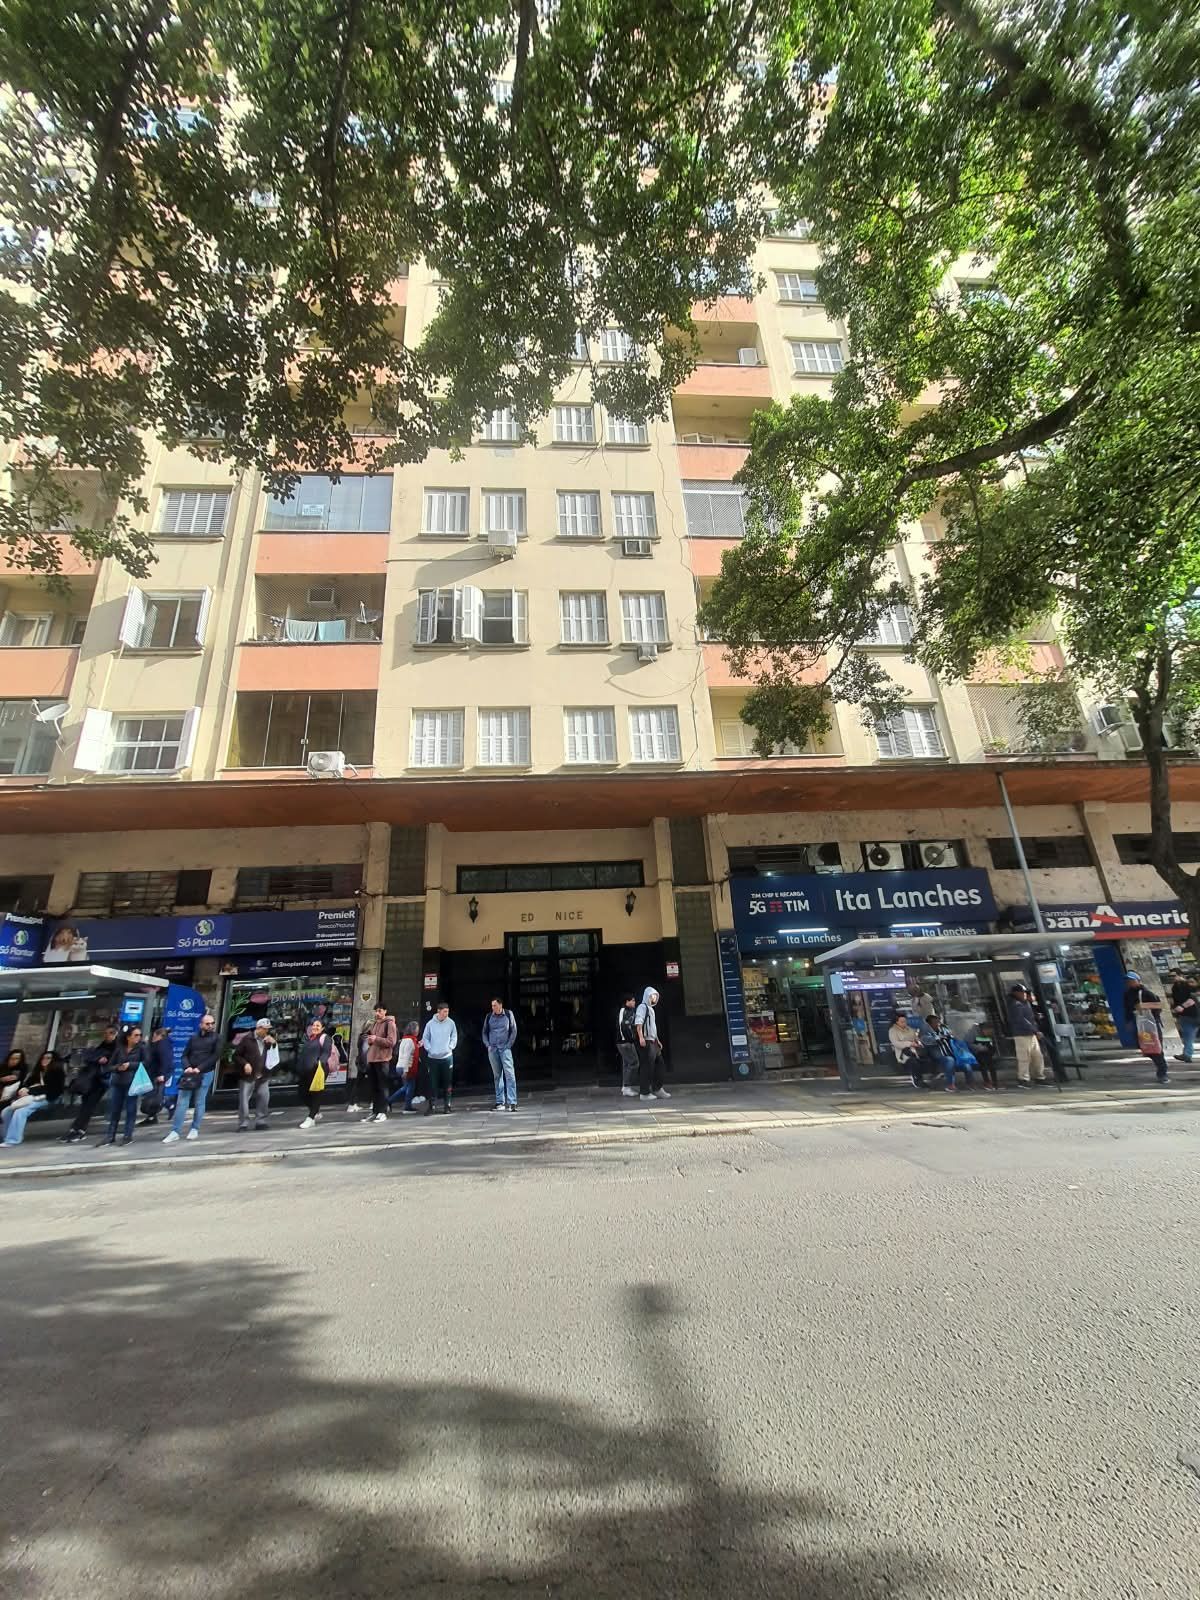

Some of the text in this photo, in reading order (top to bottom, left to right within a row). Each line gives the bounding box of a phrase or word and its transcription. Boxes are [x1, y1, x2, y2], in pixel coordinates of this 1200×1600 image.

[835, 883, 982, 911] Ita Lanches
[749, 899, 810, 915] 5G TIM
[520, 911, 583, 922] ED NICE
[937, 926, 977, 937] Lanches
[178, 938, 228, 948] Só Plantar
[786, 932, 842, 945] Ita Lanches
[178, 1010, 202, 1018] Plantar
